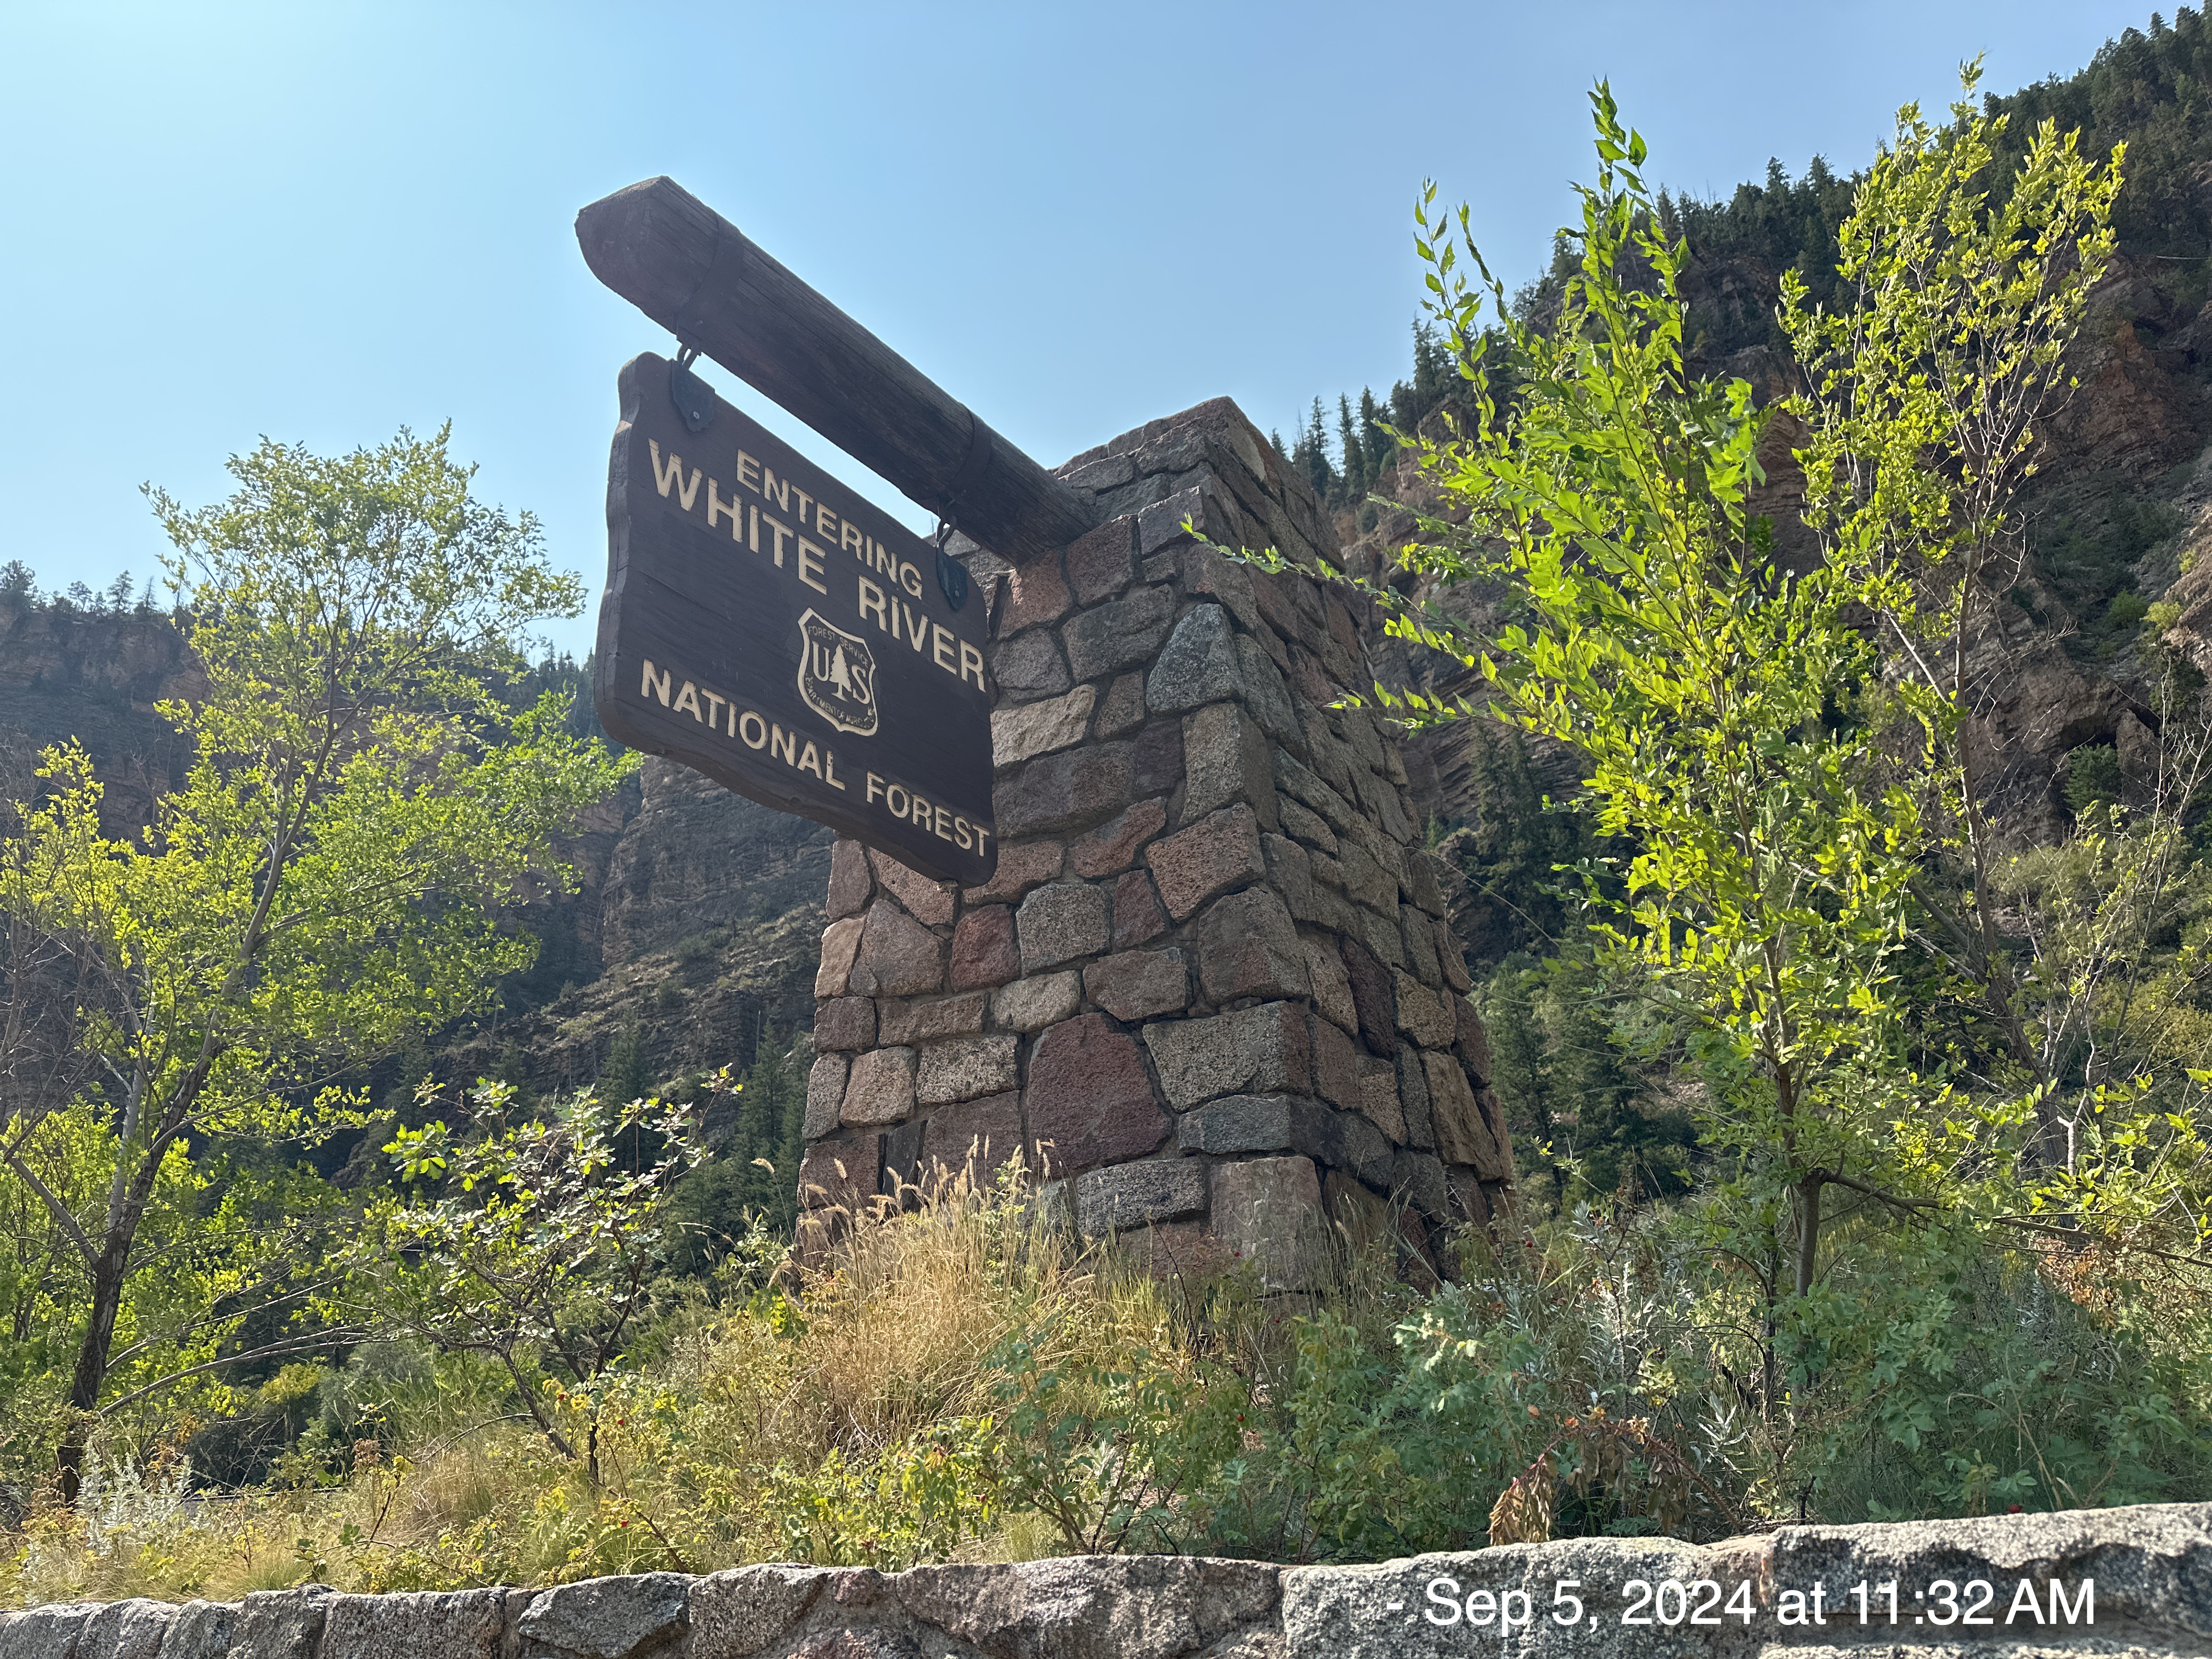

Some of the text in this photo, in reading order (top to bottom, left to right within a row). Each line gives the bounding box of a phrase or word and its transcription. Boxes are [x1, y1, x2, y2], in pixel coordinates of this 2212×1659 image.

[648, 438, 986, 693] WHITE RIVER
[737, 449, 922, 600] ENTERING
[805, 672, 837, 716] PARTMENT
[808, 625, 869, 669] FOREST SERVICE
[812, 641, 871, 704] U S
[641, 658, 990, 857] NATIONAL FOREST
